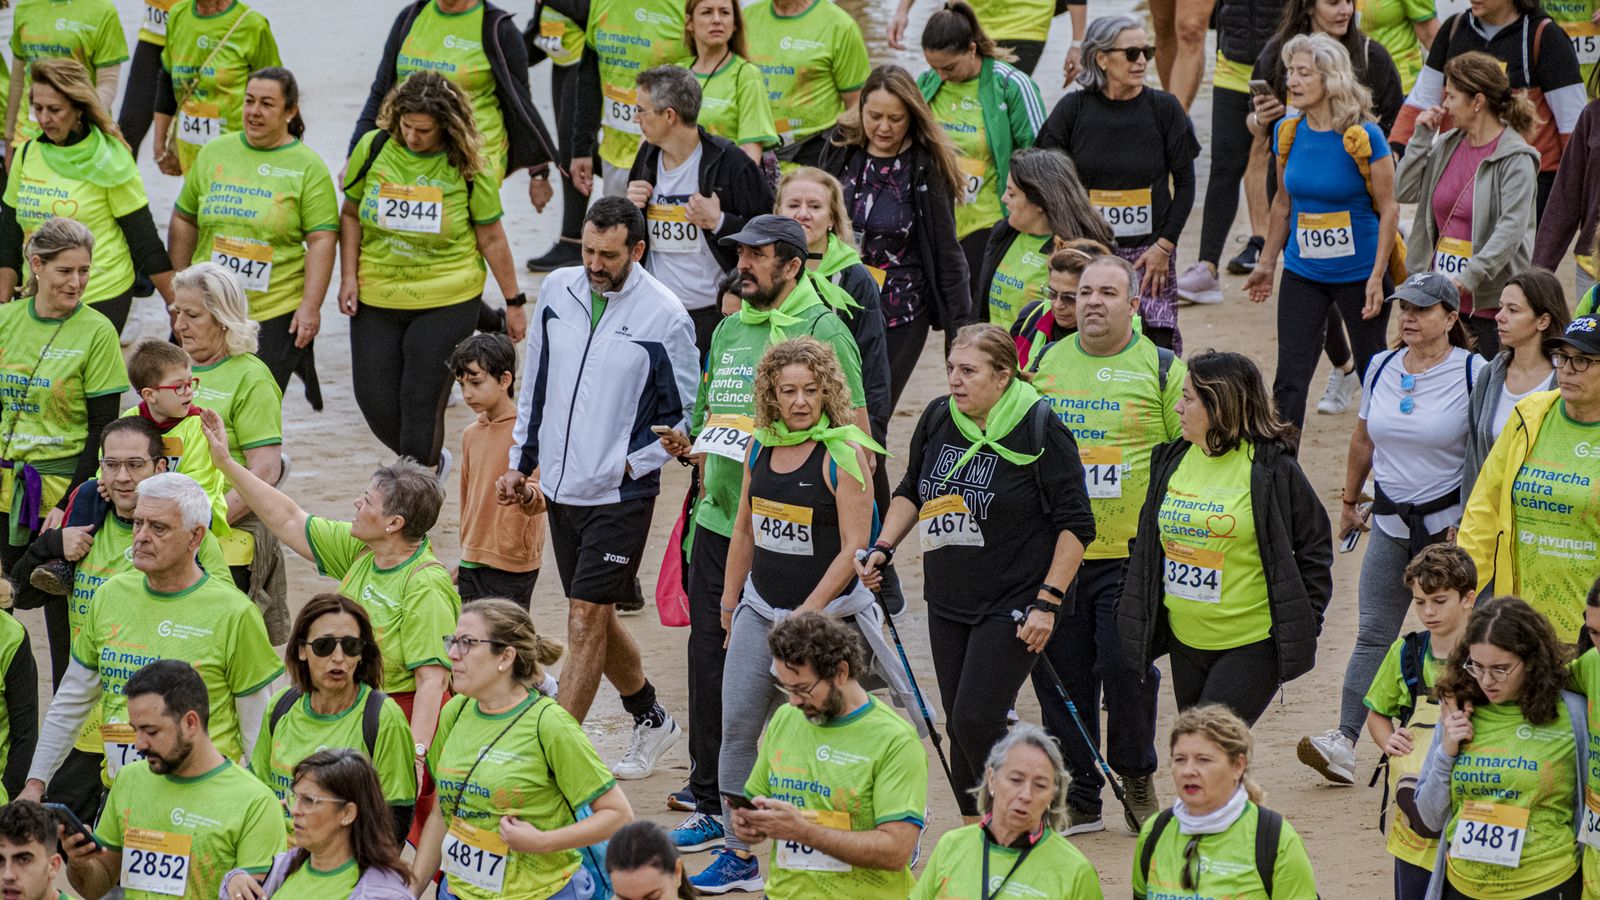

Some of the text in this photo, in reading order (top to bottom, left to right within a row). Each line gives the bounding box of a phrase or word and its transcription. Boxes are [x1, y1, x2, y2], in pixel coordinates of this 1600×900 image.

[608, 32, 652, 48] marcha
[411, 57, 456, 72] marcha
[761, 64, 795, 76] archa
[944, 122, 978, 134] archa
[26, 186, 69, 199] marcha
[224, 183, 273, 199] marcha
[385, 199, 438, 220] 2944
[1099, 205, 1149, 226] 1965
[652, 221, 699, 241] 4830
[1302, 227, 1350, 249] 1963
[218, 254, 269, 279] 2947
[721, 352, 734, 365] En
[715, 364, 753, 377] marcha
[1060, 398, 1120, 411] marcha
[1057, 412, 1085, 424] ntra
[702, 426, 752, 451] 4794
[1072, 428, 1107, 440] ncer
[936, 448, 994, 486] GYM
[1530, 467, 1591, 487] marcha
[1514, 480, 1553, 496] ontra
[1172, 498, 1225, 513] marcha
[1520, 495, 1574, 515] cáncer
[1160, 508, 1192, 523] ontra
[760, 516, 810, 543] 4845
[928, 512, 980, 537] 4675
[1163, 522, 1211, 539] cáncer
[1539, 535, 1597, 551] HYUNDAI
[1167, 560, 1218, 590] 3234
[101, 647, 116, 661] En
[1475, 756, 1538, 771] marcha
[1453, 770, 1501, 784] contra
[1462, 821, 1519, 852] 3481
[128, 849, 186, 881] 2852
[447, 840, 503, 877] 4817
